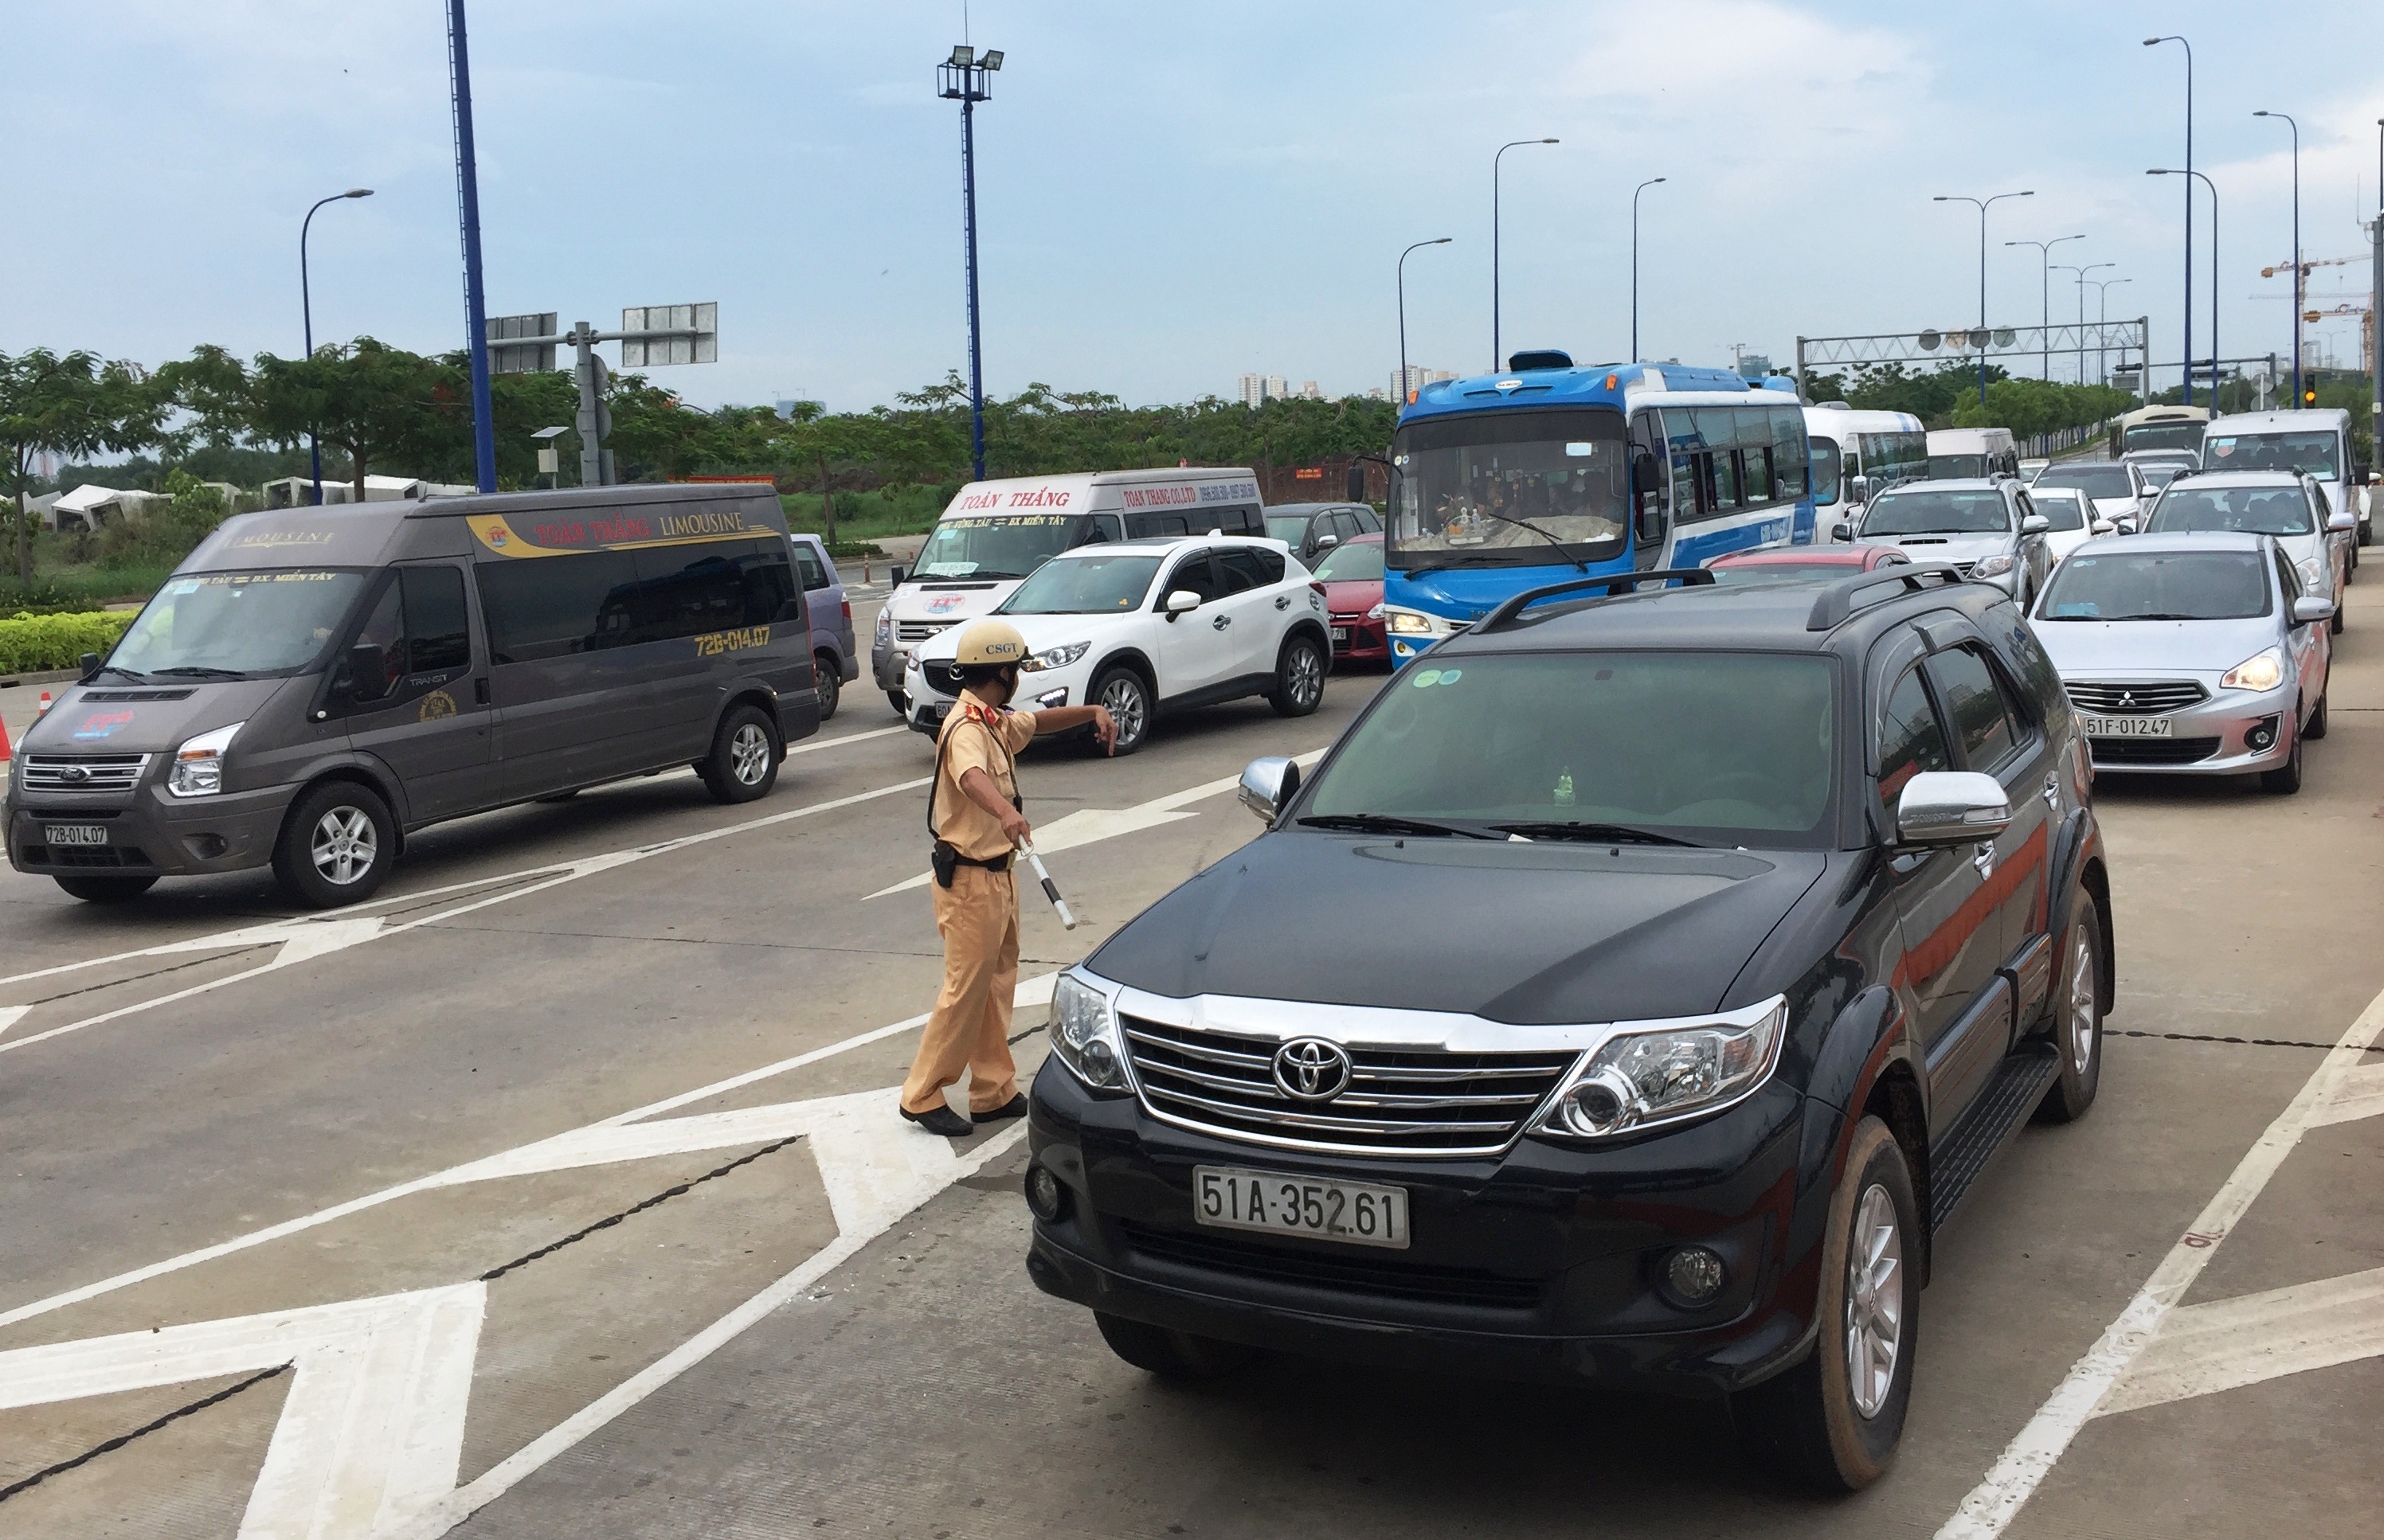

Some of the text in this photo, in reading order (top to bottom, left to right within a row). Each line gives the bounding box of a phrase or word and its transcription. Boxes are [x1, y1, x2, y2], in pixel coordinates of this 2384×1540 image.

[1008, 486, 1071, 507] THẮNG
[659, 512, 743, 536] LIMOUSINE
[694, 626, 770, 657] 72B-014.07
[985, 643, 1017, 655] CSGT
[2087, 719, 2169, 734] 51F-012.47
[46, 826, 105, 843] 72B-014.07
[1202, 1174, 1394, 1239] 51A-352.61
